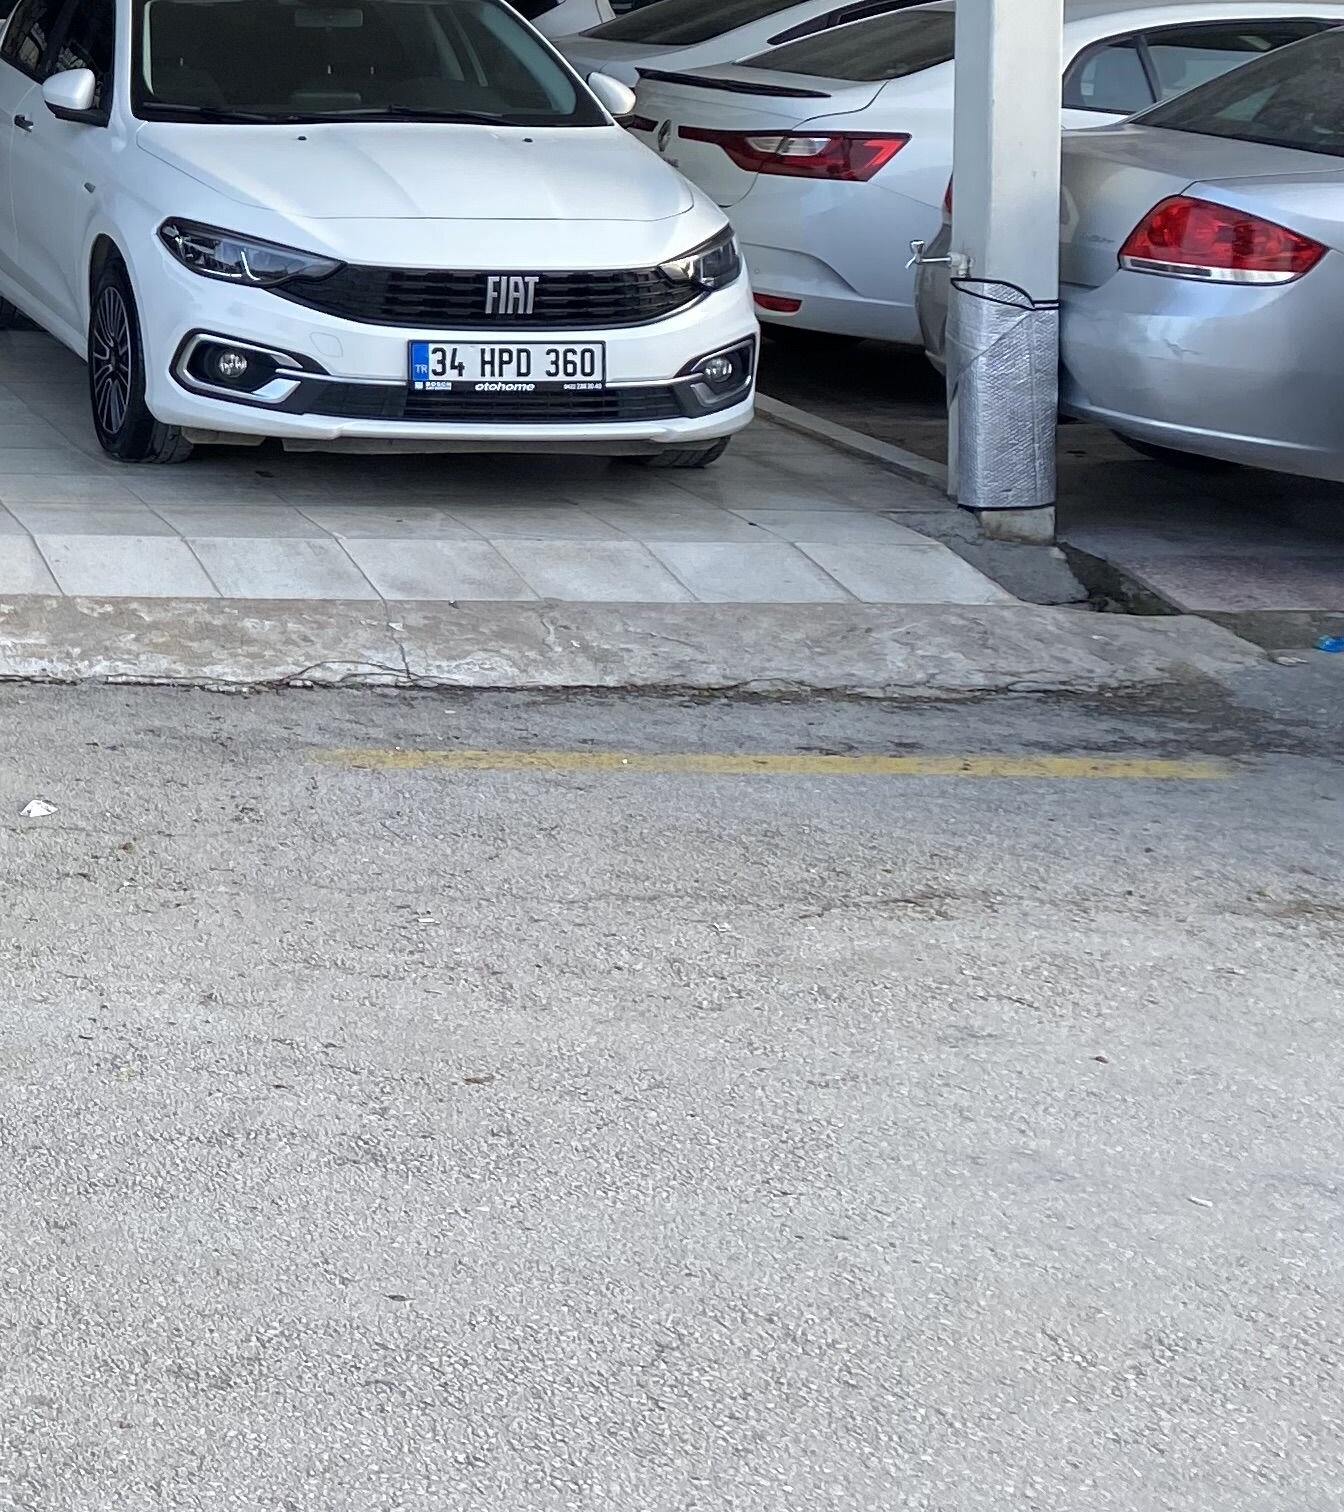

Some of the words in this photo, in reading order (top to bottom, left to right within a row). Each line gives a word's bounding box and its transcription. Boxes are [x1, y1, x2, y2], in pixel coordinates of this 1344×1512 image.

[485, 276, 540, 314] FIAT
[415, 364, 428, 374] TR
[431, 347, 465, 377] 34
[480, 347, 532, 377] HPD
[545, 347, 596, 377] 360
[474, 382, 535, 392] otohome
